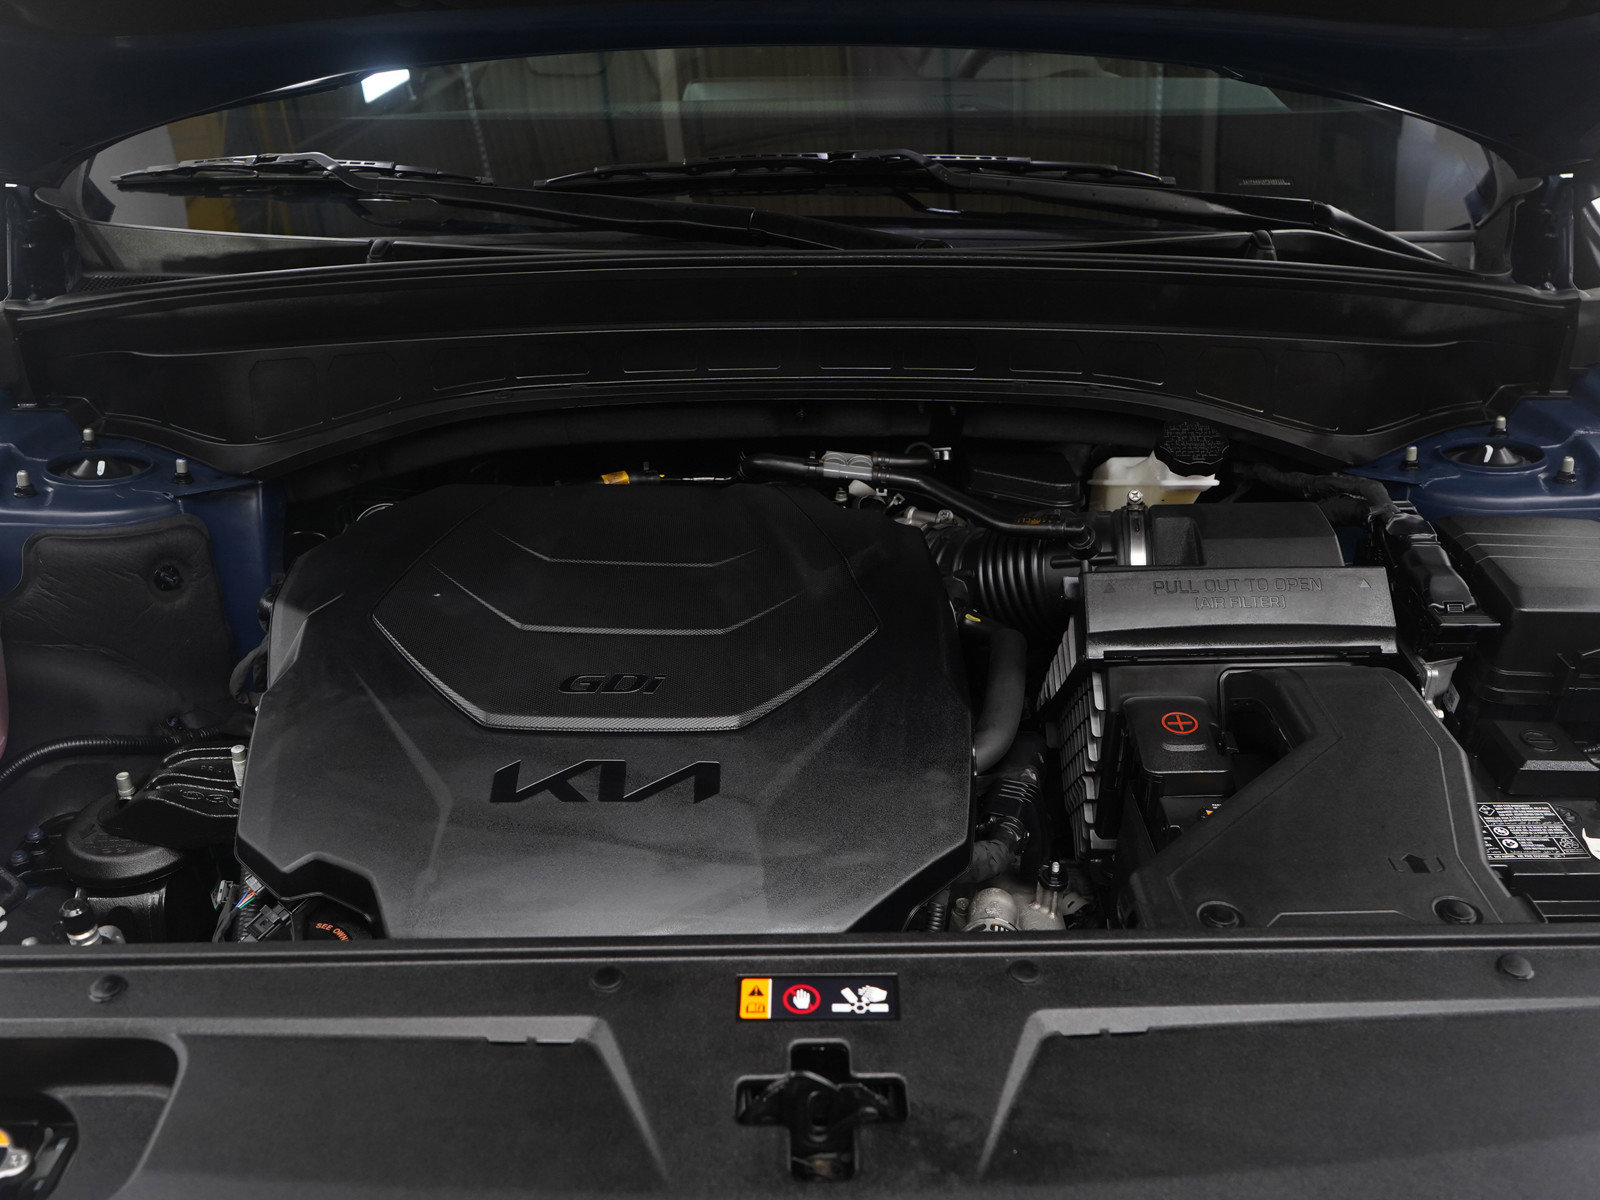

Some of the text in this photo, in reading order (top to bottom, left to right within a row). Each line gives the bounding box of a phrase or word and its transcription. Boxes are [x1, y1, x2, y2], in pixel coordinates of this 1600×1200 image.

[1153, 577, 1323, 595] PULL OUT TO OPEN
[1194, 595, 1287, 610] (AIR FILTER)
[490, 759, 721, 803] KIA
[315, 922, 334, 931] SEE
